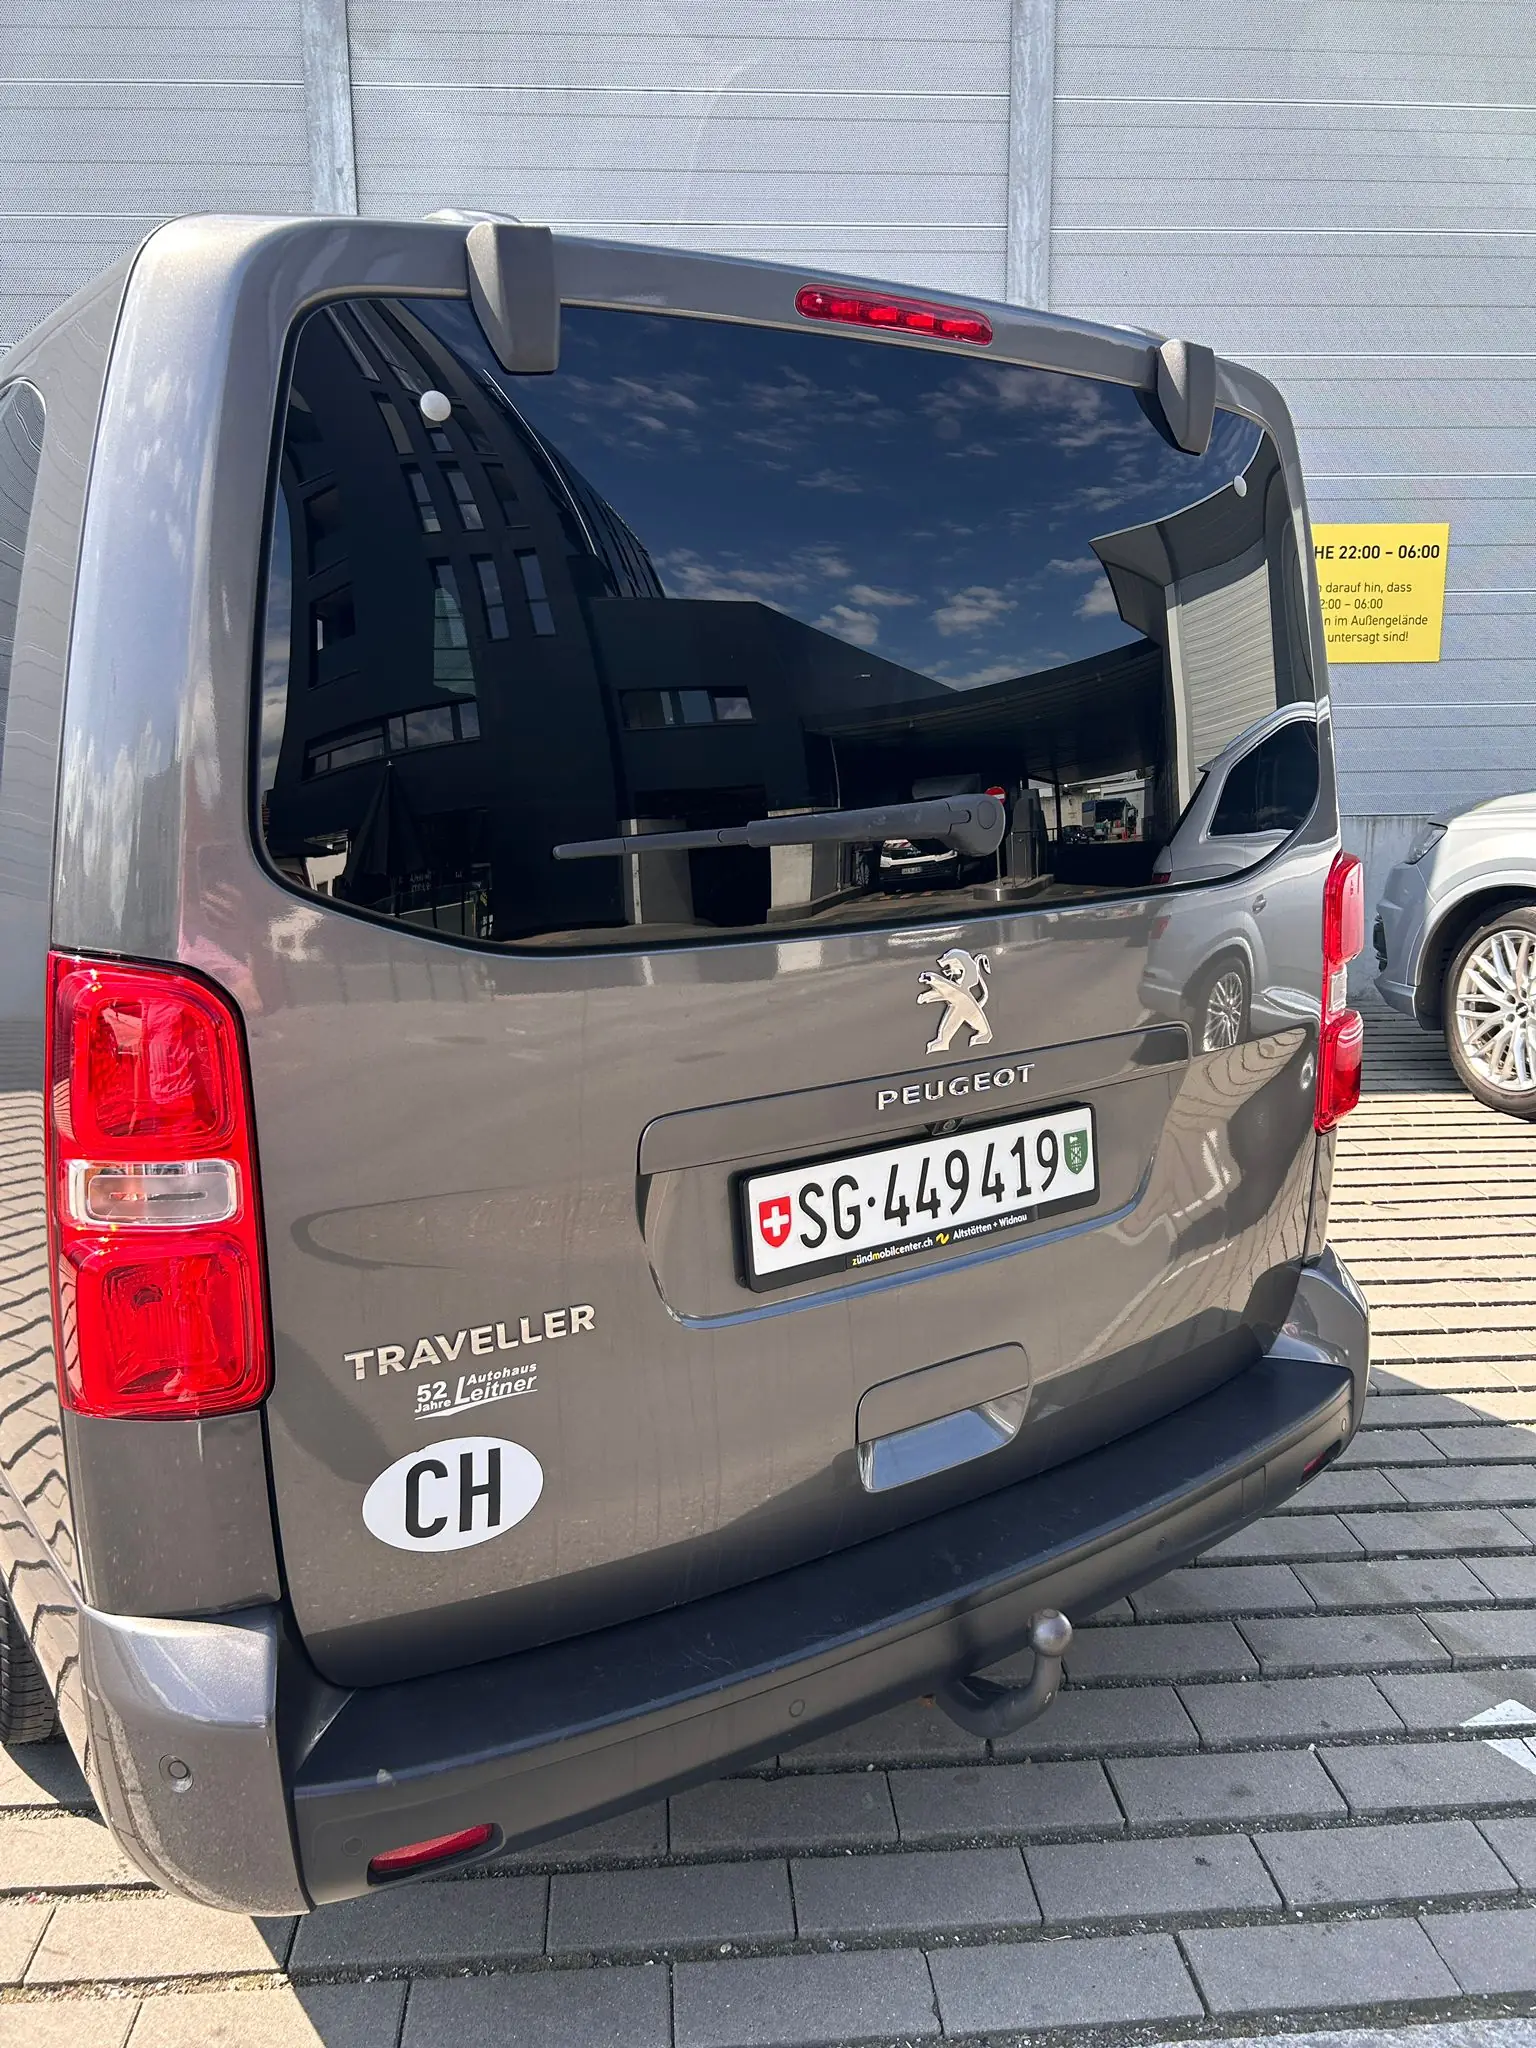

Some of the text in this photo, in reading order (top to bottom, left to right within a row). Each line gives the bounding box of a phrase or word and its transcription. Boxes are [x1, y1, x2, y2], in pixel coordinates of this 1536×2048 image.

[1313, 545, 1334, 559] HE
[1339, 545, 1380, 559] 22:00
[1398, 545, 1440, 559] 06:00
[1325, 582, 1361, 593] darauf
[1364, 582, 1383, 594] hin,
[1387, 582, 1412, 593] dass
[1319, 598, 1341, 610] 2:00
[1354, 598, 1383, 610] 06:00
[1334, 615, 1348, 626] im
[1351, 614, 1428, 629] Außengelände
[1327, 630, 1409, 645] untersagt sind!
[876, 1063, 1035, 1110] PEUGEOT
[852, 1237, 934, 1266] zündmobilcenter.ch
[953, 1223, 992, 1240] Altstätten
[999, 1213, 1028, 1227] Widnau
[344, 1303, 596, 1380] TRAVELLER
[467, 1363, 537, 1386] Autohaus
[416, 1380, 448, 1403] 52
[454, 1375, 537, 1405] Leitner
[414, 1399, 452, 1413] Jahre
[405, 1447, 501, 1539] CH
